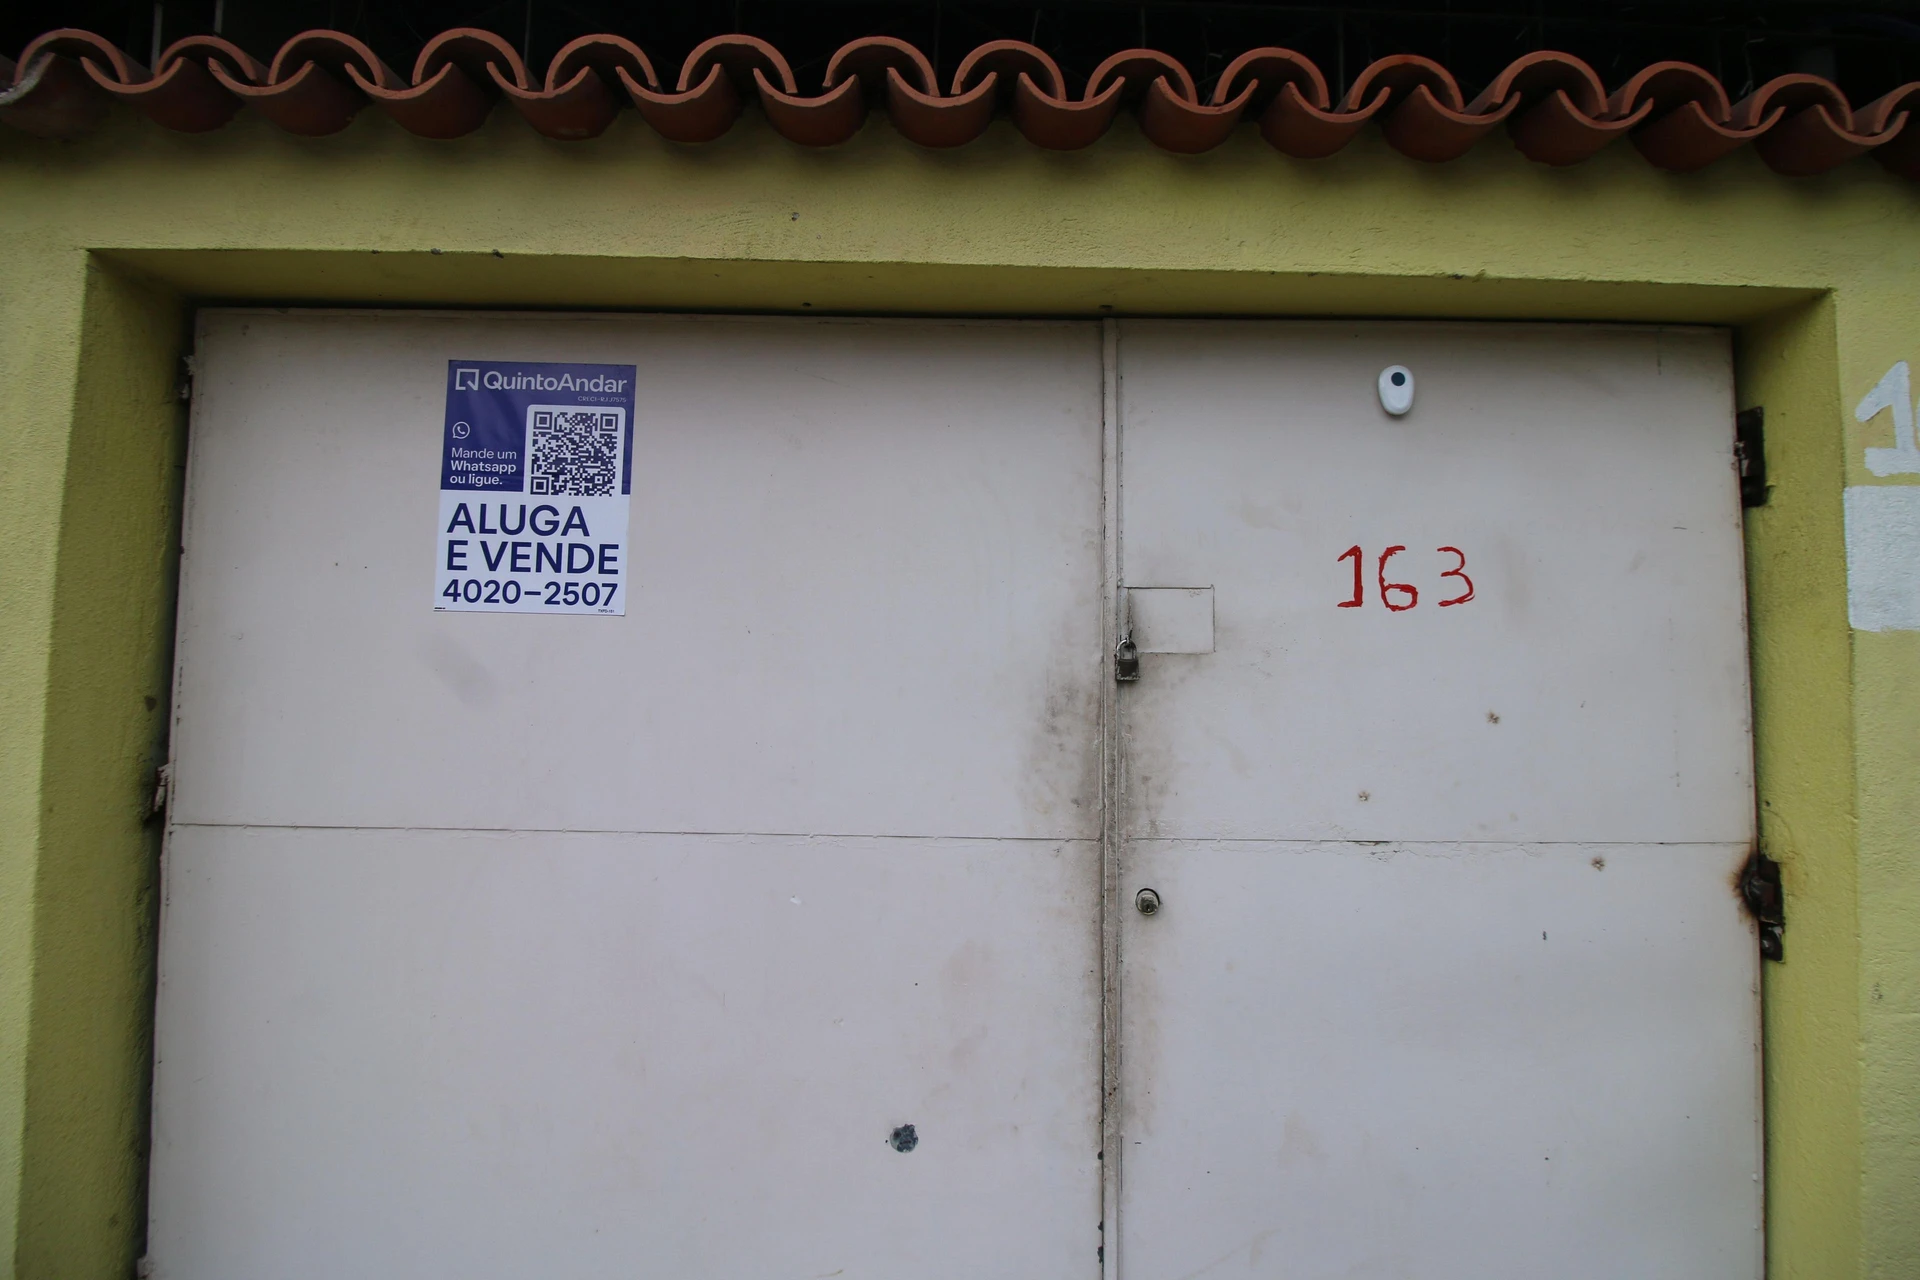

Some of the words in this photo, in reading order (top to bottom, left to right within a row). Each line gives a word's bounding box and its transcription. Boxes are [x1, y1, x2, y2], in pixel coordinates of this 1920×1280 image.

[483, 371, 627, 392] QuintoAndar
[451, 447, 494, 459] Mande
[497, 450, 517, 460] um
[451, 460, 517, 475] Whatsapp
[449, 475, 466, 485] ou
[468, 474, 503, 488] ligue.
[446, 502, 590, 537] ALUGA
[446, 539, 469, 571] E
[479, 540, 620, 575] VENDE
[1337, 545, 1475, 612] 163
[442, 578, 618, 607] 4020-2507
